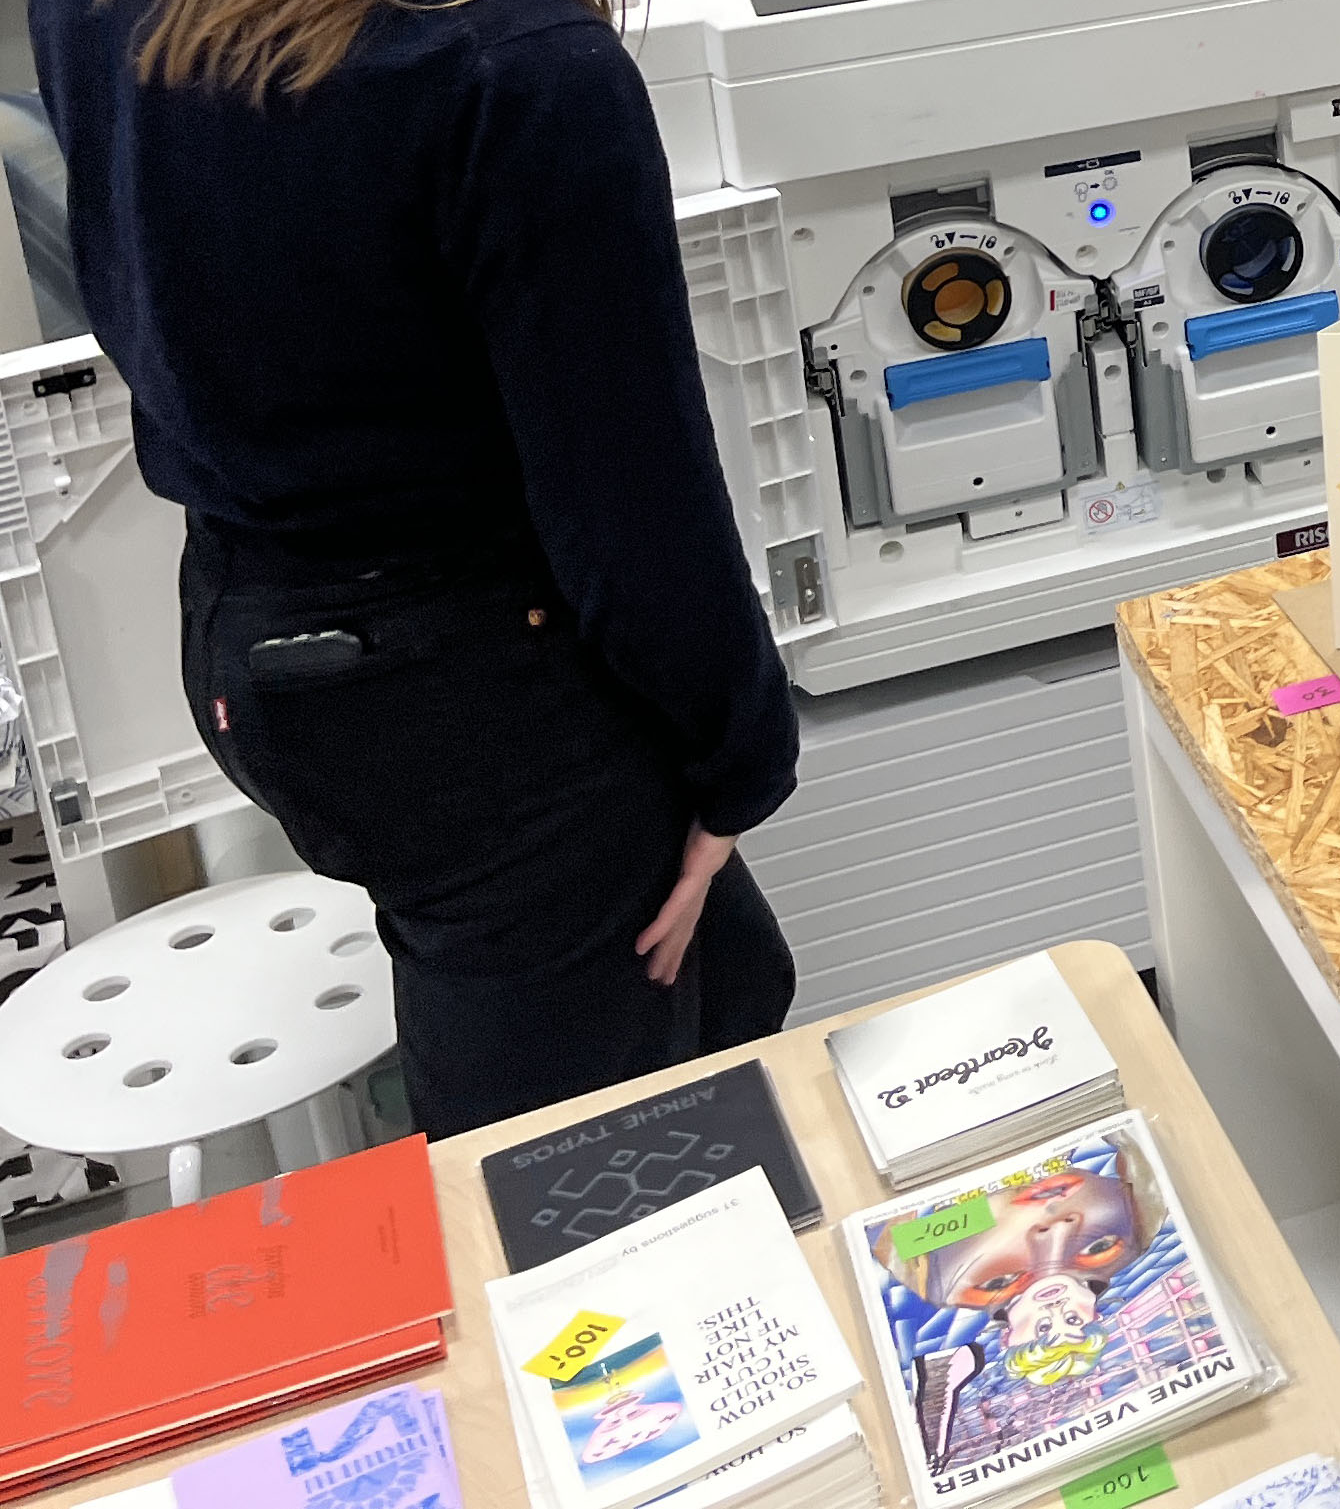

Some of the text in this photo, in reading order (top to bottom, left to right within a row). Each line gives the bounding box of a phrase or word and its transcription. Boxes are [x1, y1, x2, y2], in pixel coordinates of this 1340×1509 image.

[1295, 525, 1329, 548] RIS
[877, 1025, 1054, 1109] Heartbeat 2
[511, 1085, 716, 1170] ARKHE TYPOS
[641, 1207, 720, 1248] suggestions
[621, 1244, 639, 1257] by
[695, 1295, 761, 1331] THIS:
[703, 1309, 765, 1344] LIKE
[693, 1324, 801, 1385] MY HAIR
[701, 1317, 781, 1366] IF NOT
[709, 1354, 811, 1413] SHOULD
[720, 1349, 785, 1392] I CUT
[715, 1389, 777, 1431] HOW
[932, 1355, 1236, 1495] MINE VENNINNER
